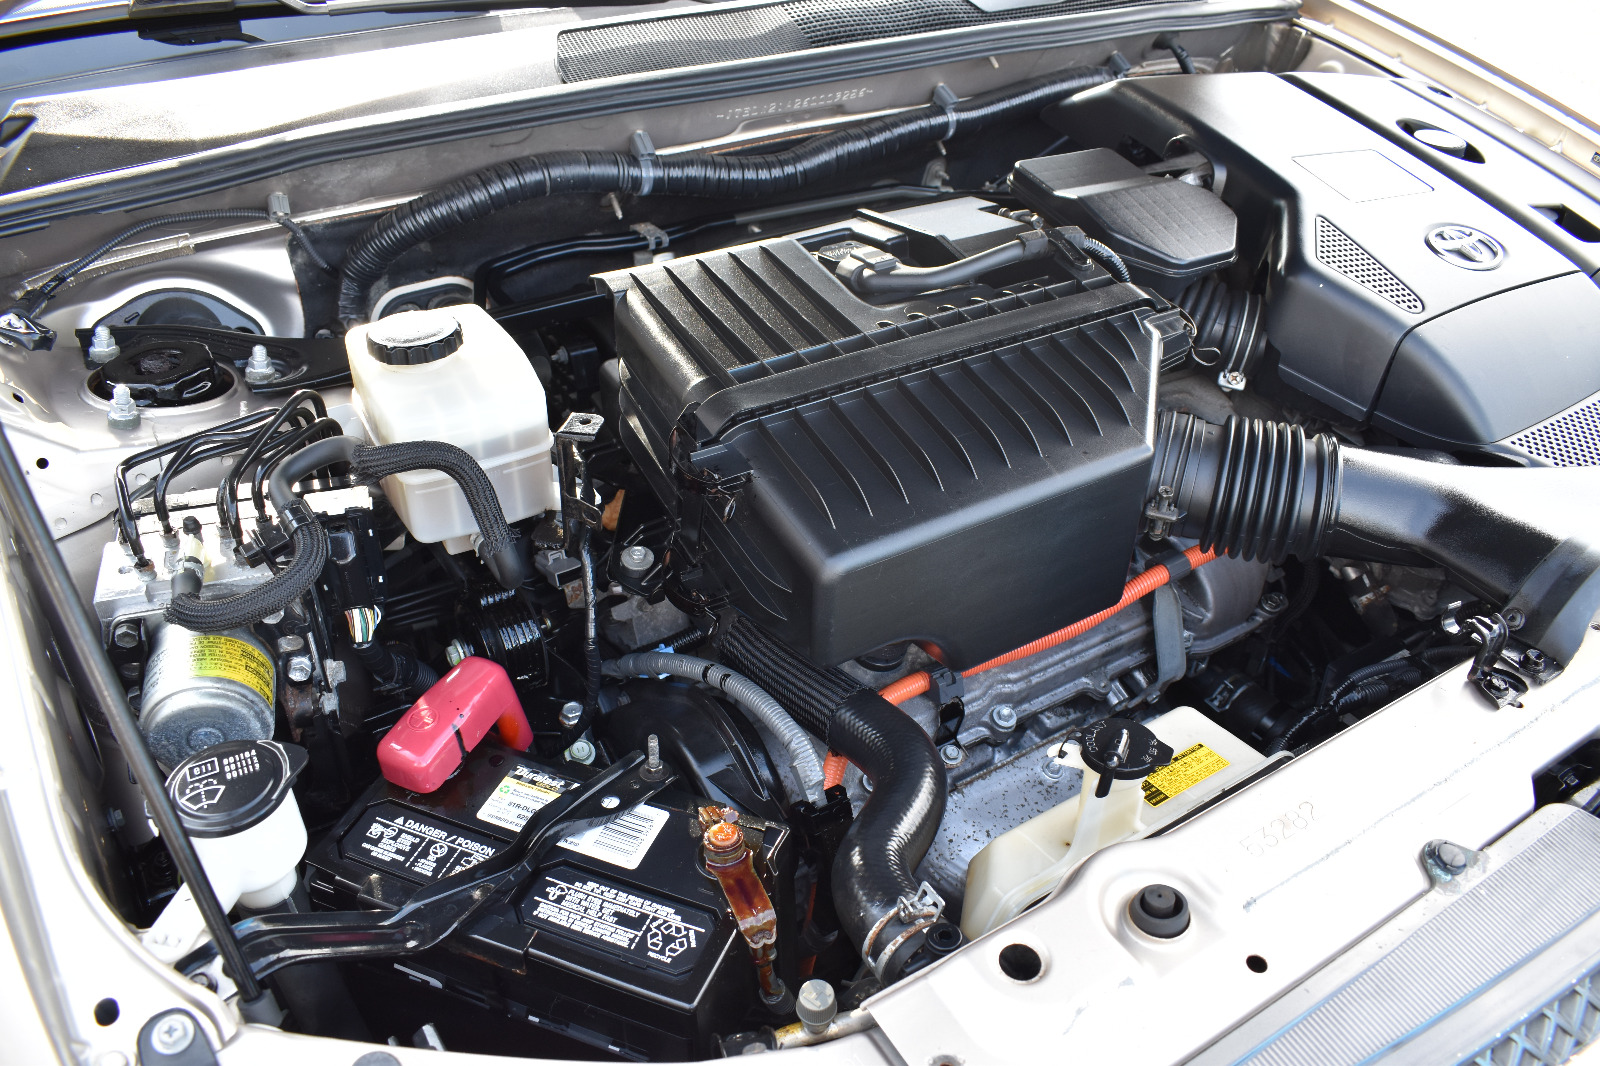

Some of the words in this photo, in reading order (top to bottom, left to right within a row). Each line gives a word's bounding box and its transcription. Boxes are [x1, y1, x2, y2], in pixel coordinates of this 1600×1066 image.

[514, 765, 565, 789] Duralast
[404, 819, 448, 839] DANGER
[445, 833, 457, 843] /
[454, 836, 495, 856] POISON
[564, 894, 581, 904] WITH
[601, 907, 615, 916] GET
[567, 889, 587, 900] FLUSH
[560, 899, 586, 912] MEDICAL
[585, 908, 602, 918] HELP
[601, 913, 618, 923] FAST
[647, 951, 673, 964] RECYCLE
